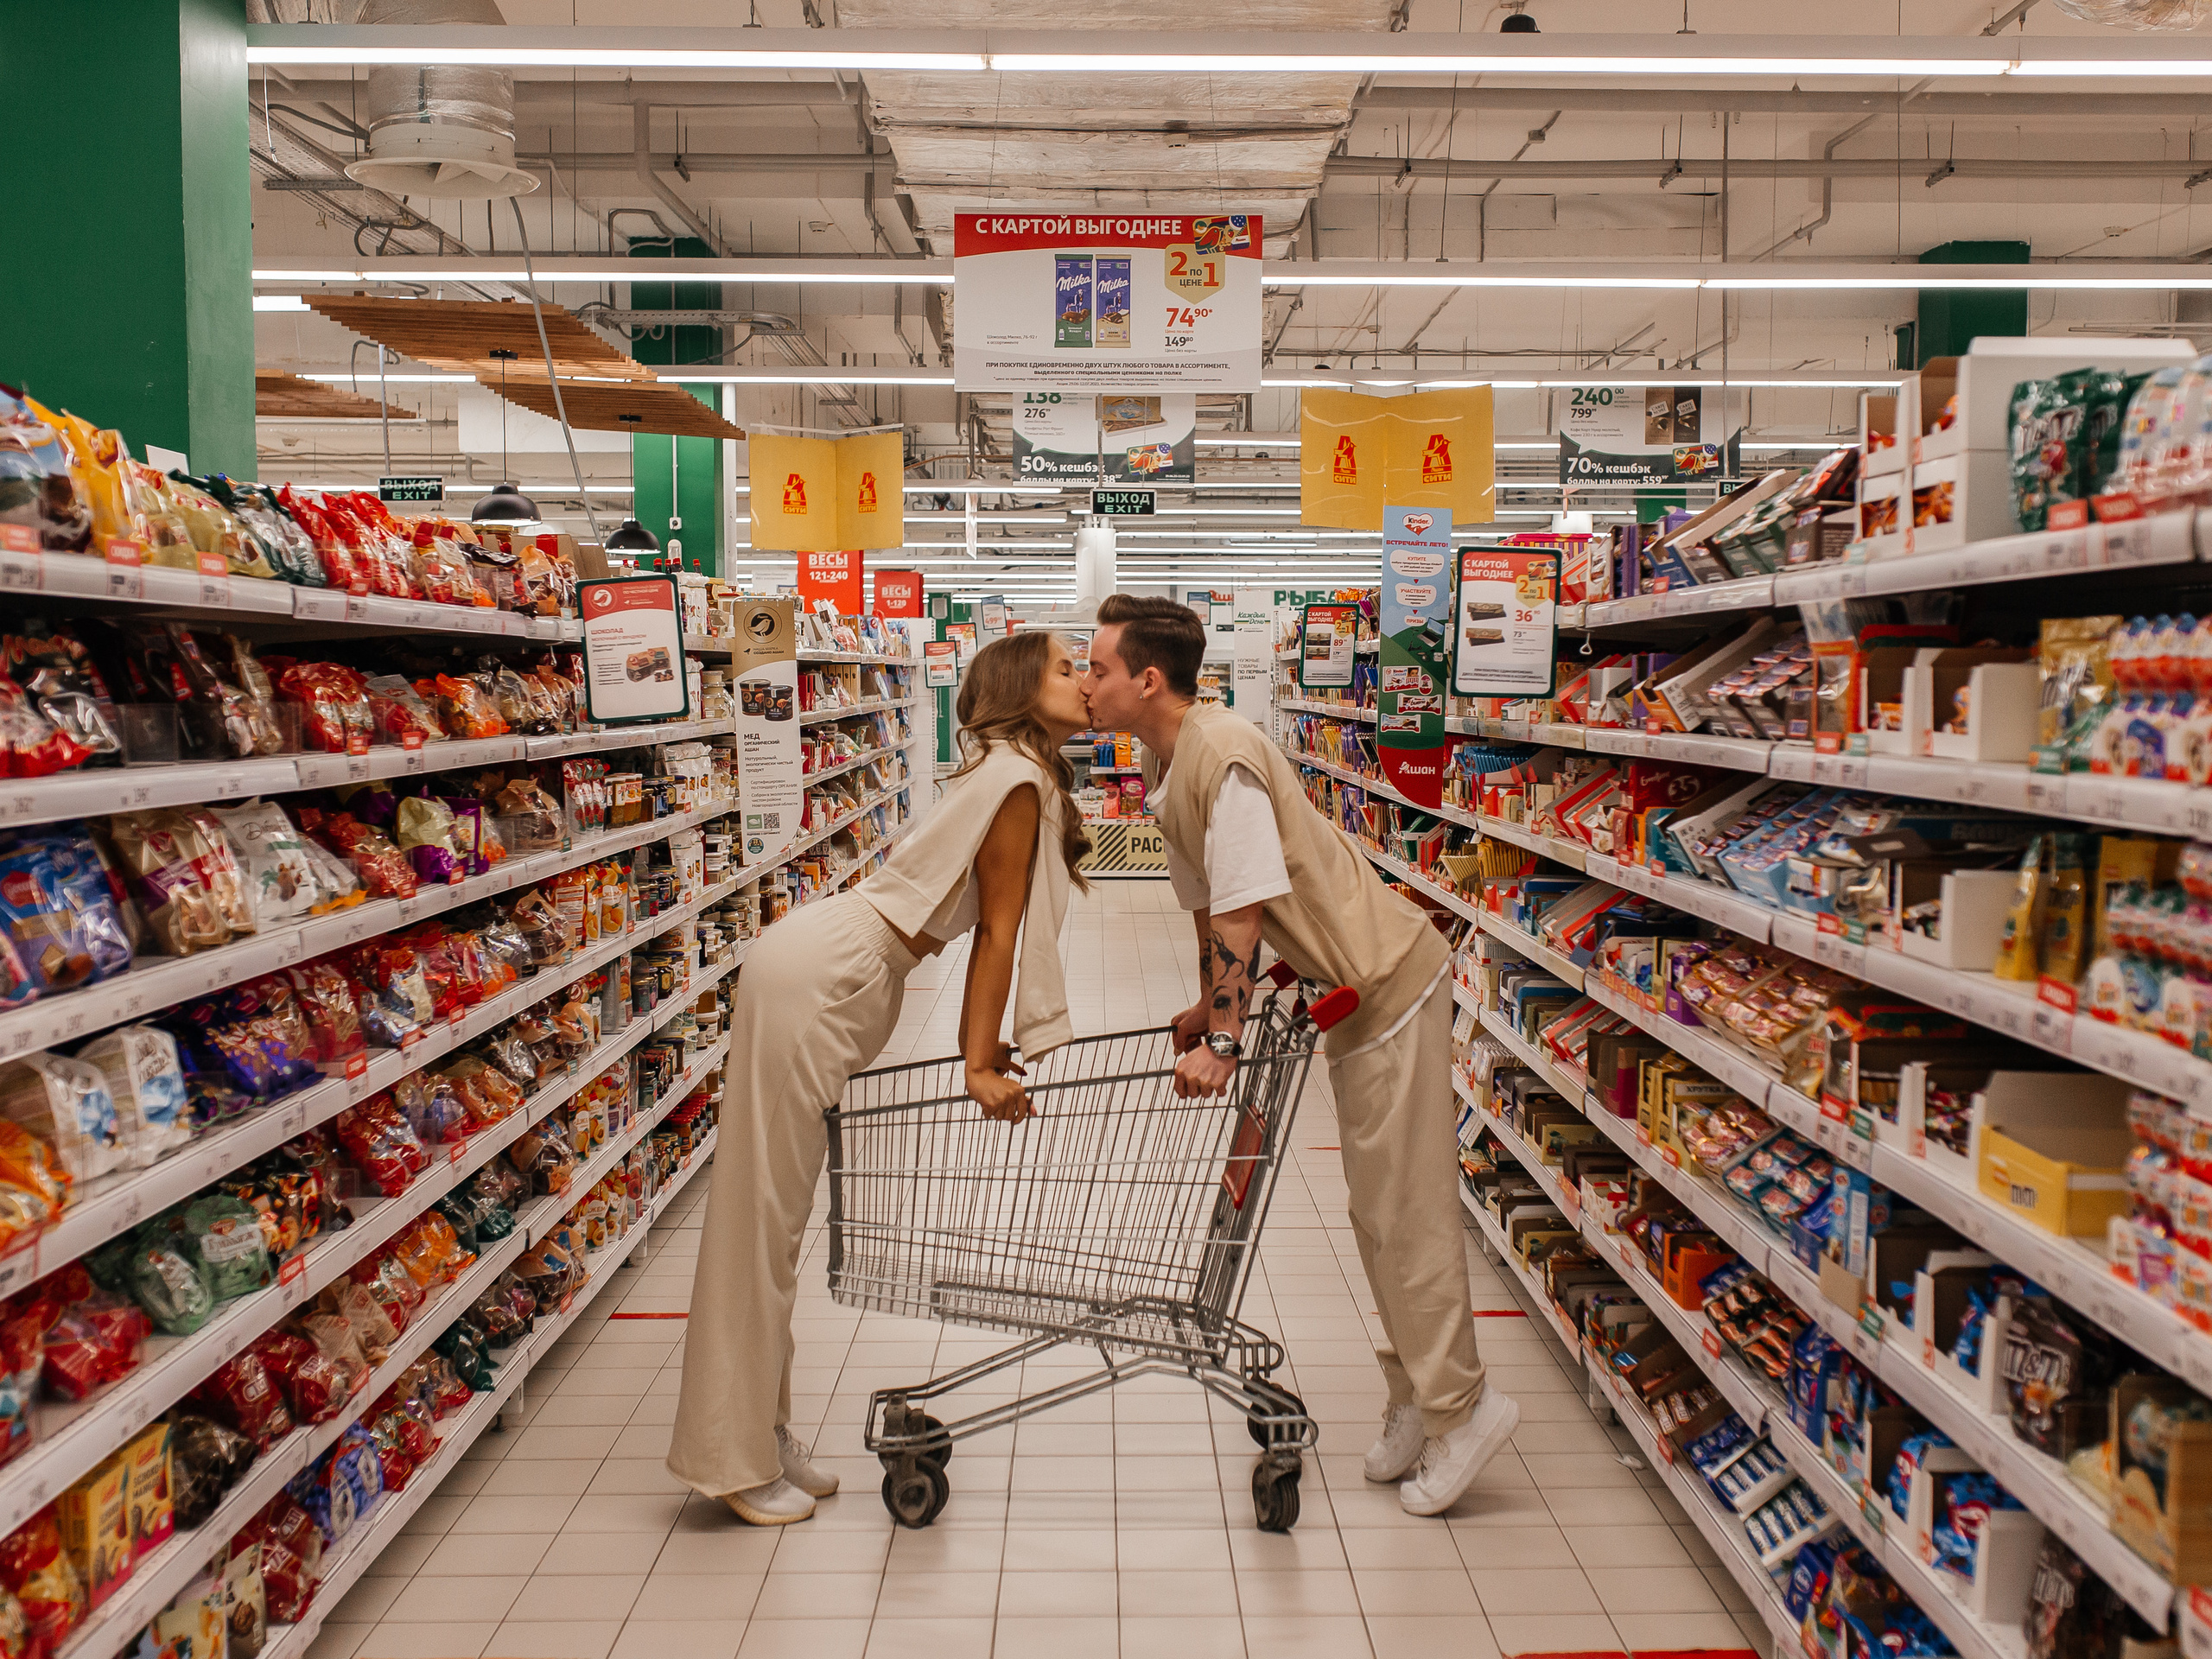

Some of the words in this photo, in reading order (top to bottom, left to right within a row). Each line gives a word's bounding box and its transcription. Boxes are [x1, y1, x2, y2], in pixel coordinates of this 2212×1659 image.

[976, 219, 988, 233] С
[992, 214, 1071, 234] КАРТОЙ
[1076, 219, 1182, 238] ВЫГОДНЕЕ
[1170, 251, 1187, 276] 2
[1179, 279, 1202, 288] ЦЕНЕ
[1204, 263, 1219, 287] 1
[1056, 274, 1092, 291] Milka
[1097, 277, 1129, 294] Milka
[1571, 387, 1613, 406] 240
[1020, 456, 1058, 472] 50%
[1567, 458, 1604, 474] 70%
[1605, 463, 1651, 474] кешбэк
[1334, 475, 1356, 484] СИТИ
[1423, 474, 1452, 483] СИТИ
[385, 479, 438, 492] ВЫХОД
[392, 491, 432, 500] EXIT
[1097, 493, 1150, 505] ВЫХОД
[1104, 505, 1142, 513] EXIT
[809, 554, 849, 565] ВЕСЫ
[1471, 560, 1509, 569] КАРТОЙ
[809, 571, 849, 580] 121-240
[1464, 569, 1514, 579] ВЫГОДНЕЕ
[881, 587, 911, 596] ВЕСЫ
[1519, 580, 1529, 593] 2
[1536, 586, 1545, 600] 1
[1516, 610, 1533, 622] 36
[1398, 760, 1436, 775] Ашан
[1132, 836, 1166, 854] РАС
